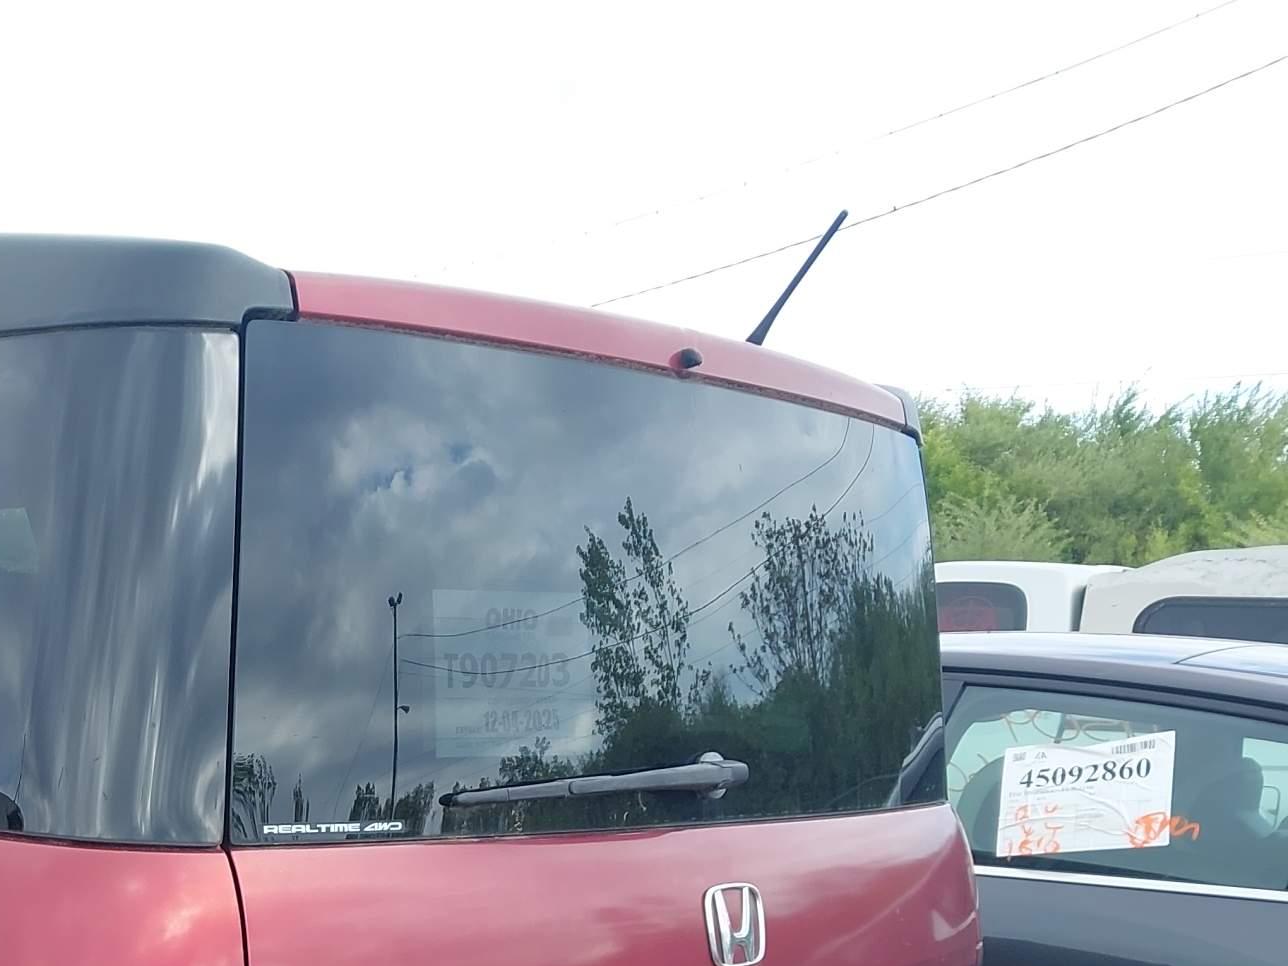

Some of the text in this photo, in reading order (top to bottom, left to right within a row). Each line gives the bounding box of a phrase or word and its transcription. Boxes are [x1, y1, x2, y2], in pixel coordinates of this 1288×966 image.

[485, 608, 537, 631] OHIO
[444, 652, 570, 688] T907203
[1019, 758, 1151, 788] 45092860
[263, 821, 403, 834] REALTIME 4WD
